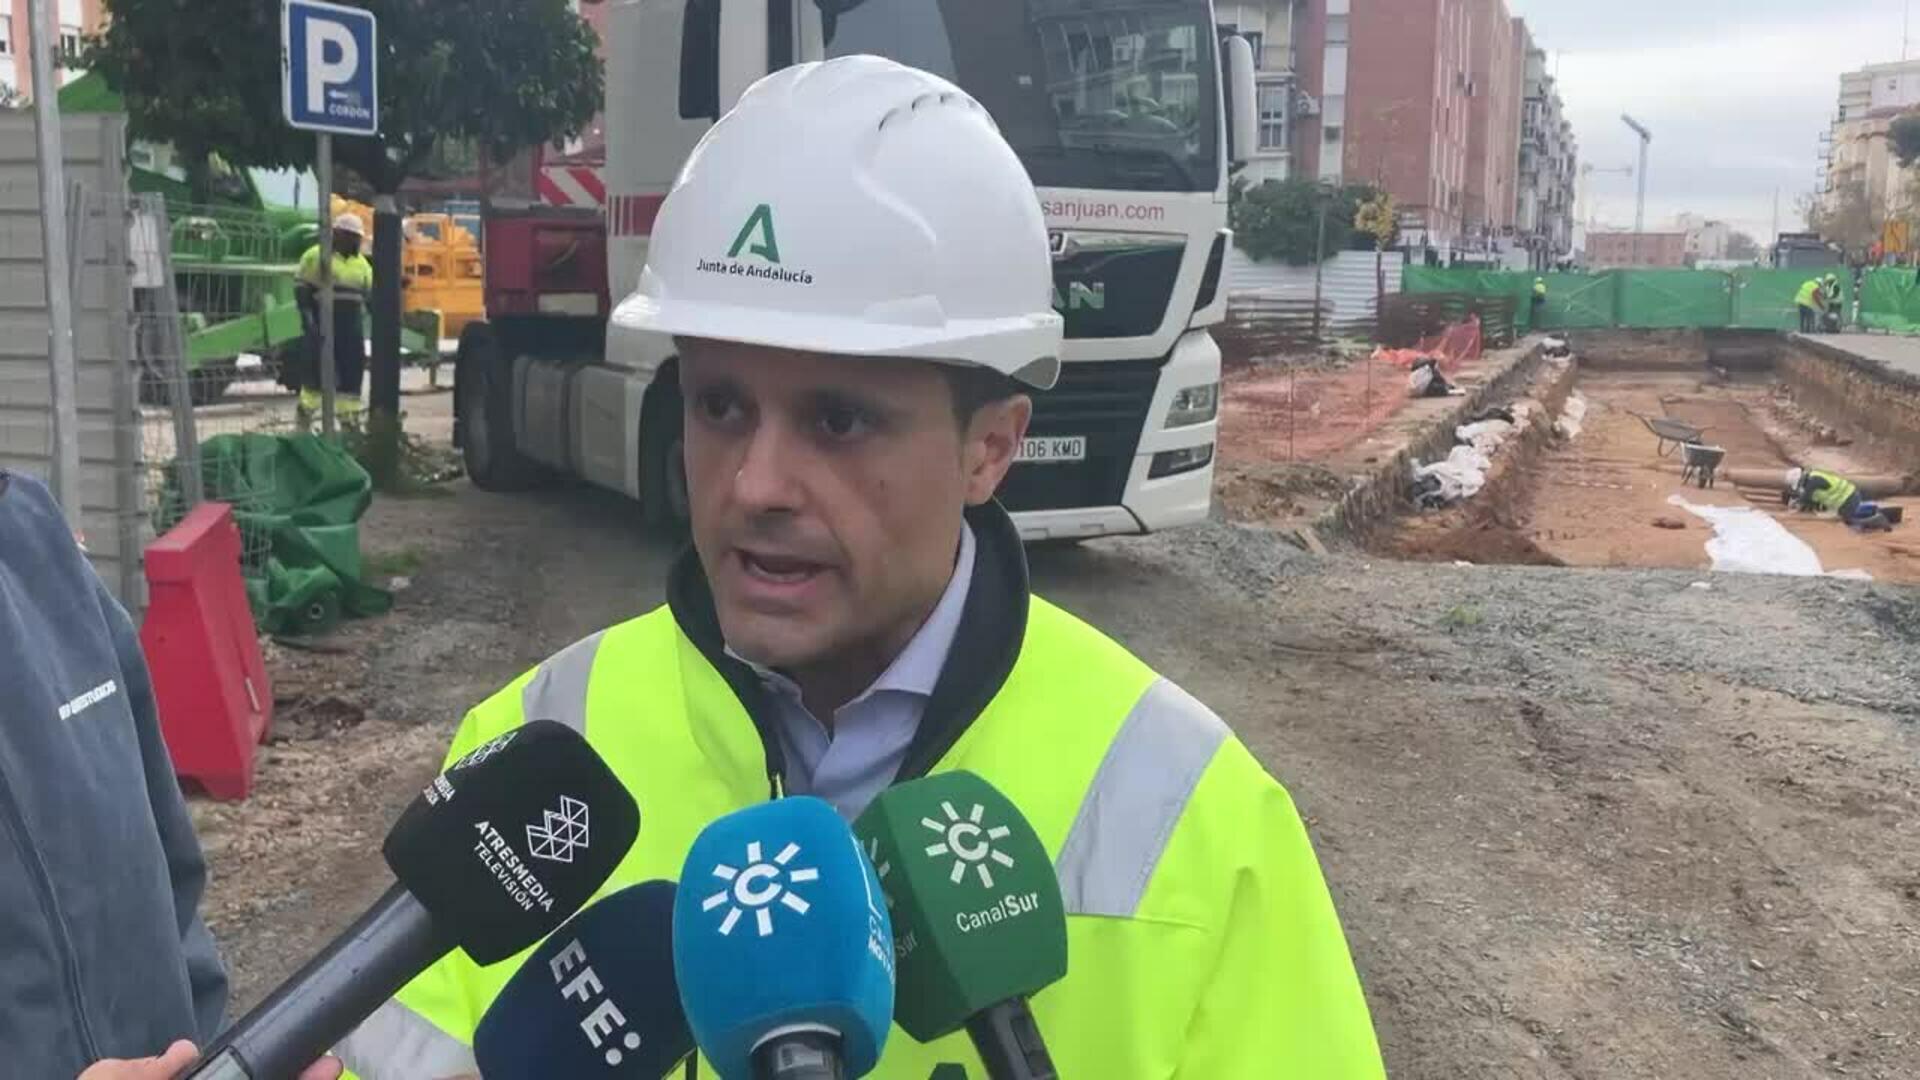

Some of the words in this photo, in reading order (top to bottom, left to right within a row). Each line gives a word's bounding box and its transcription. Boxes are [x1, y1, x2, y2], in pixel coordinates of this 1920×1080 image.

[305, 16, 358, 114] P
[1043, 200, 1165, 222] sanjuan.com
[696, 258, 727, 273] Junta
[729, 262, 745, 275] de
[746, 265, 813, 285] Andalucía
[474, 820, 556, 913] ATRESMEDIA
[474, 840, 534, 911] TELEVISIÓN
[956, 892, 1040, 933] CanalSur
